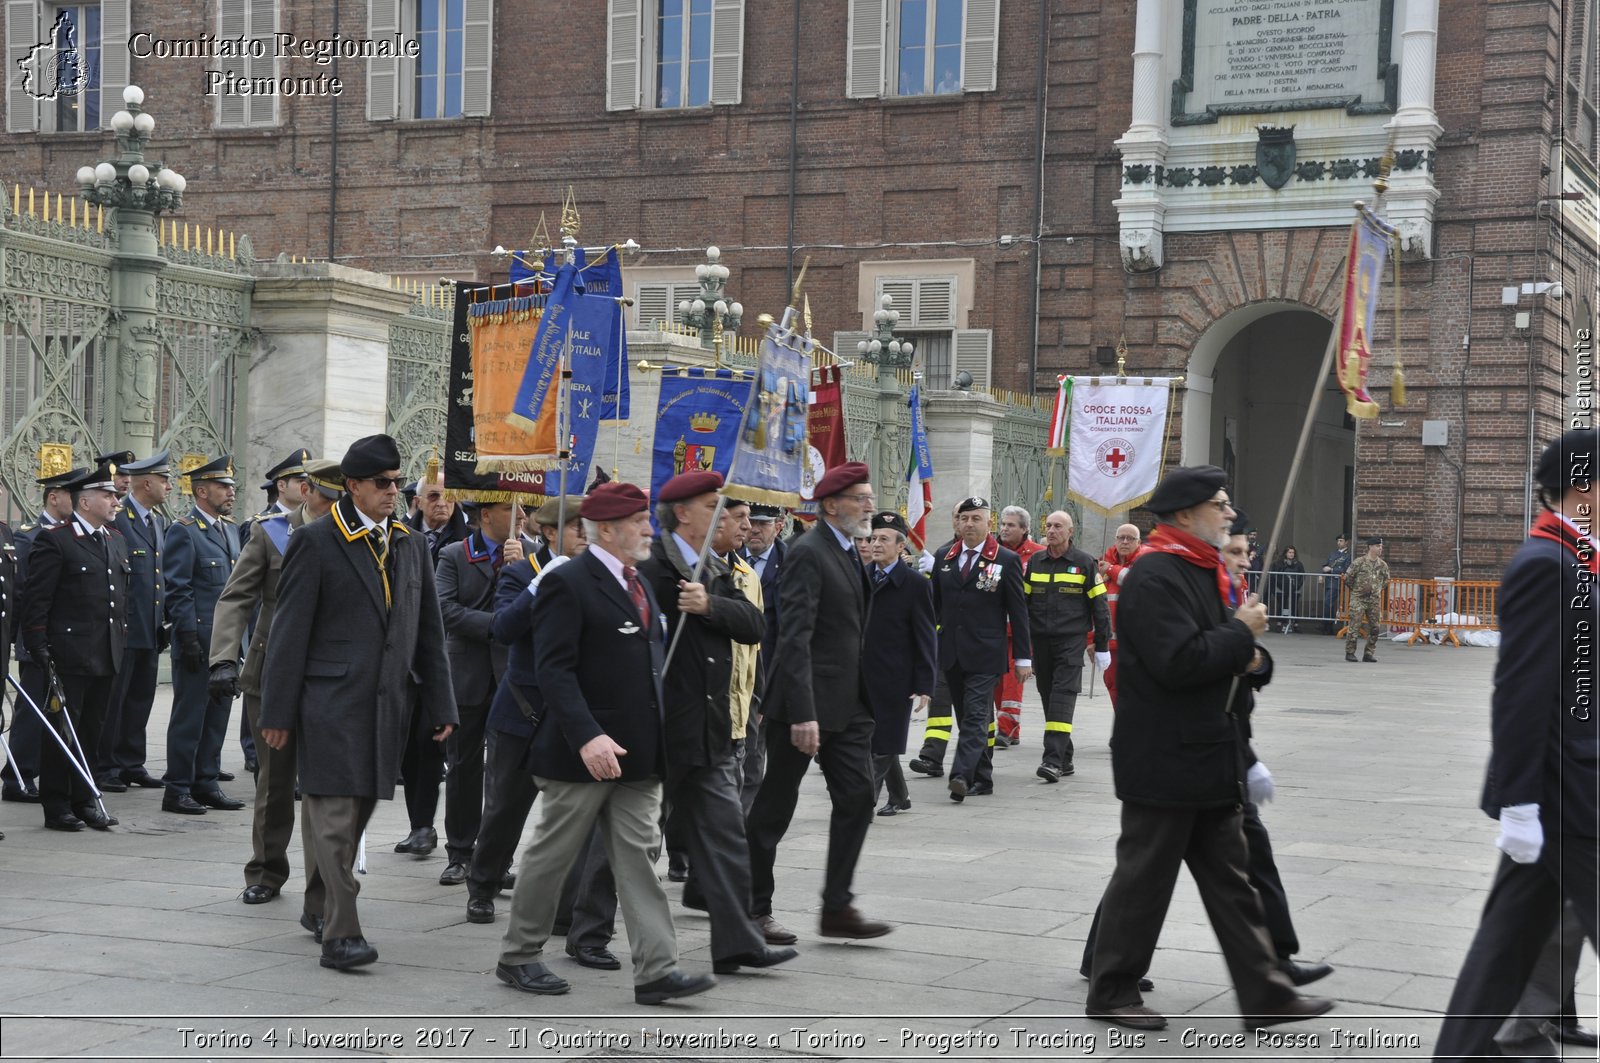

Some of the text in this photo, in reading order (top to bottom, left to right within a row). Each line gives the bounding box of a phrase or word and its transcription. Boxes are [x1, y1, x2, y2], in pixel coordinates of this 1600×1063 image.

[1208, 5, 1248, 15] ACCLAMATO
[1251, 3, 1270, 11] DAGLI
[1273, 1, 1300, 9] ITALIANI
[1232, 9, 1340, 26] PADRE DELLA PATRIA
[1286, 26, 1315, 35] RICORDO
[1272, 35, 1303, 44] TORINESE
[1306, 49, 1345, 58] COMPIANTO
[1284, 60, 1303, 68] VOTO
[1307, 57, 1341, 66] POPOLARE
[1255, 68, 1316, 78] INSEPARABILMENTE
[1273, 77, 1298, 85] DESTINI
[1306, 83, 1344, 91] MONARCHIA
[695, 385, 732, 400] Nazionale
[1083, 405, 1152, 415] CROCE ROSSA
[1095, 416, 1138, 425] ITALIANA
[454, 450, 477, 462] SEZI
[498, 471, 543, 485] TORINO
